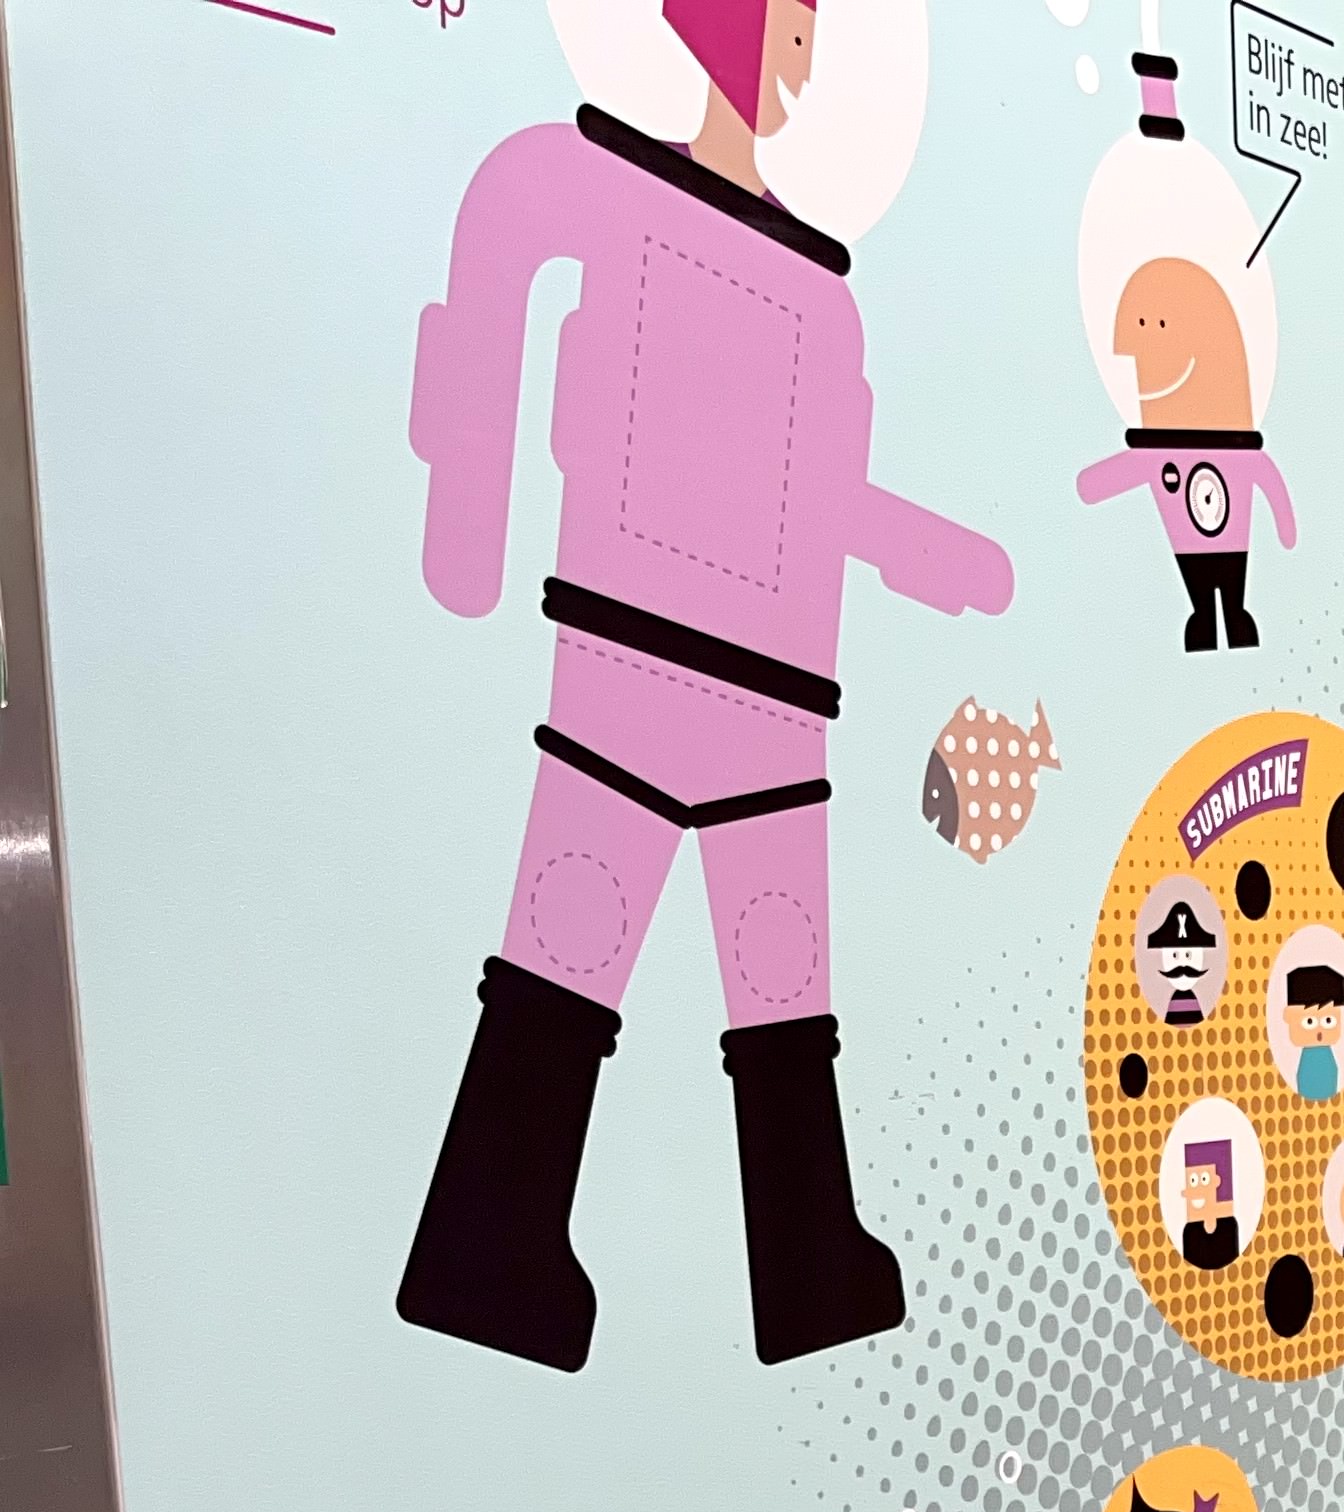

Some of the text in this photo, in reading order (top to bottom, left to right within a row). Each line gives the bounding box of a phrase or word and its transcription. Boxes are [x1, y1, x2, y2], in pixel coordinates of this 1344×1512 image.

[1248, 33, 1295, 97] Blijf
[1249, 90, 1328, 159] in zee!
[1186, 752, 1301, 848] SUBMARINE
